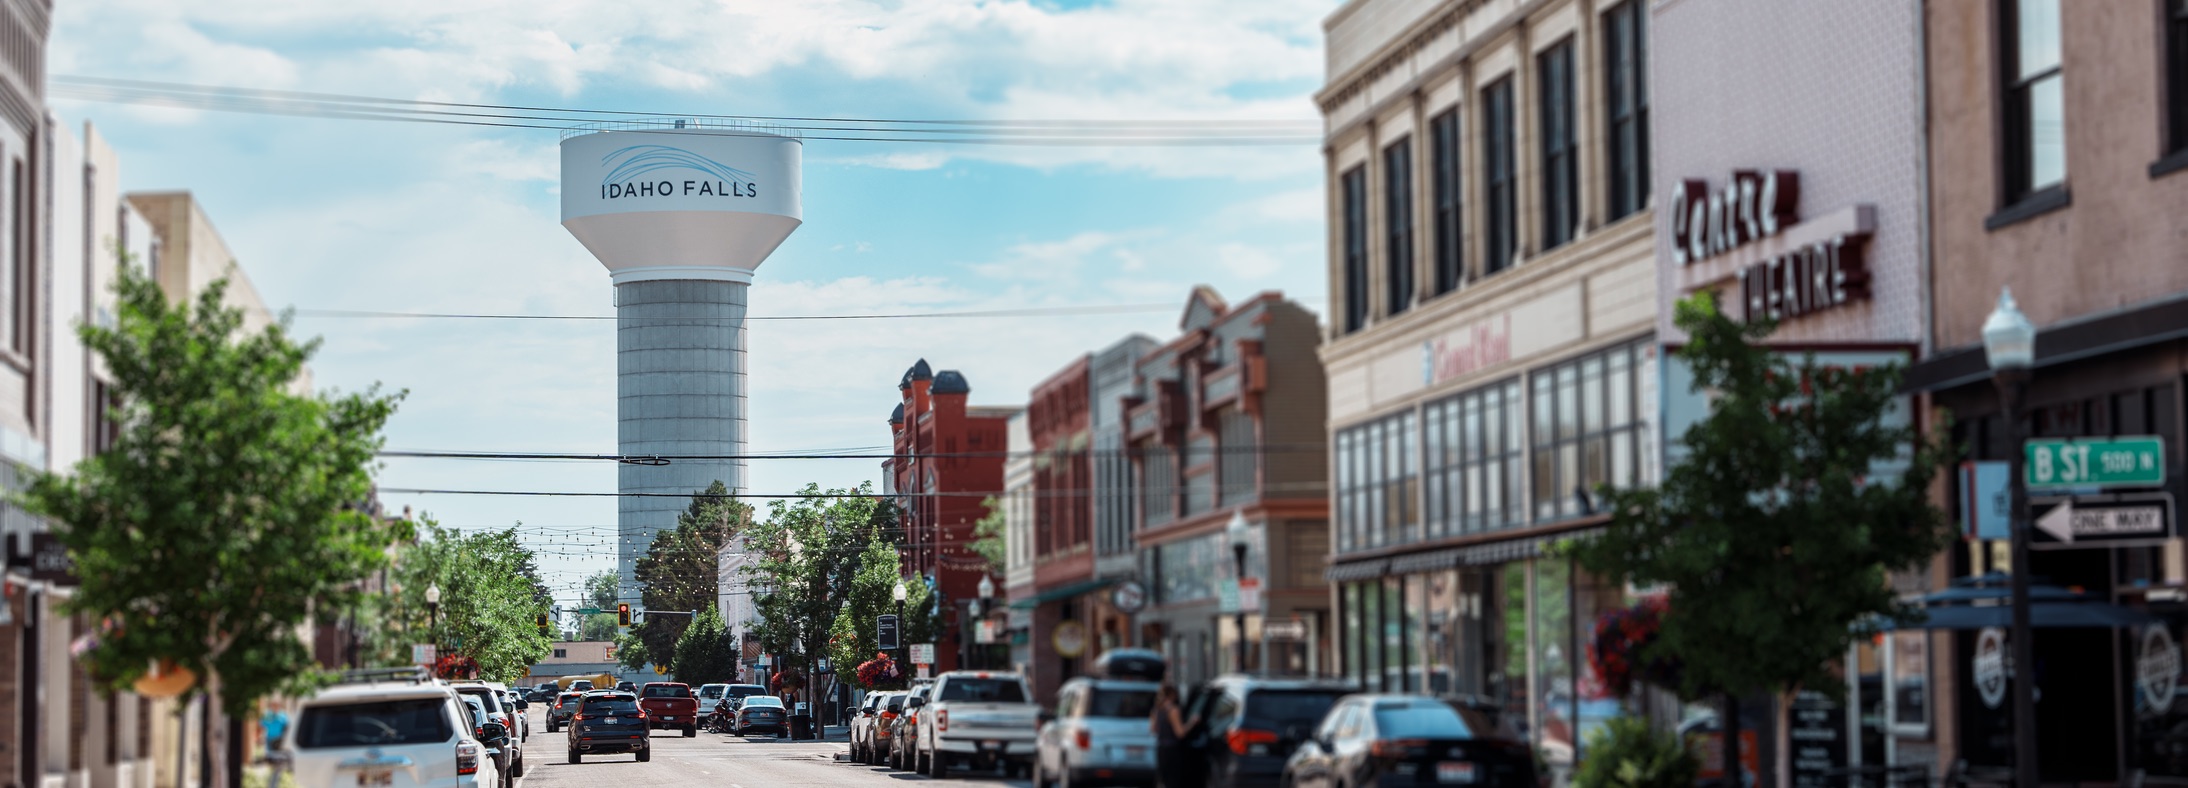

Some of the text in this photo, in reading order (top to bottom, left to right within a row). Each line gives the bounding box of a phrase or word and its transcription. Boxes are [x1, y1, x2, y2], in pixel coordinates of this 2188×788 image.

[601, 180, 757, 200] IDAHO FALLS
[1736, 232, 1847, 325] THEATRE
[2033, 445, 2054, 483] B
[2139, 451, 2155, 472] N
[2071, 507, 2156, 531] ONE WAY
